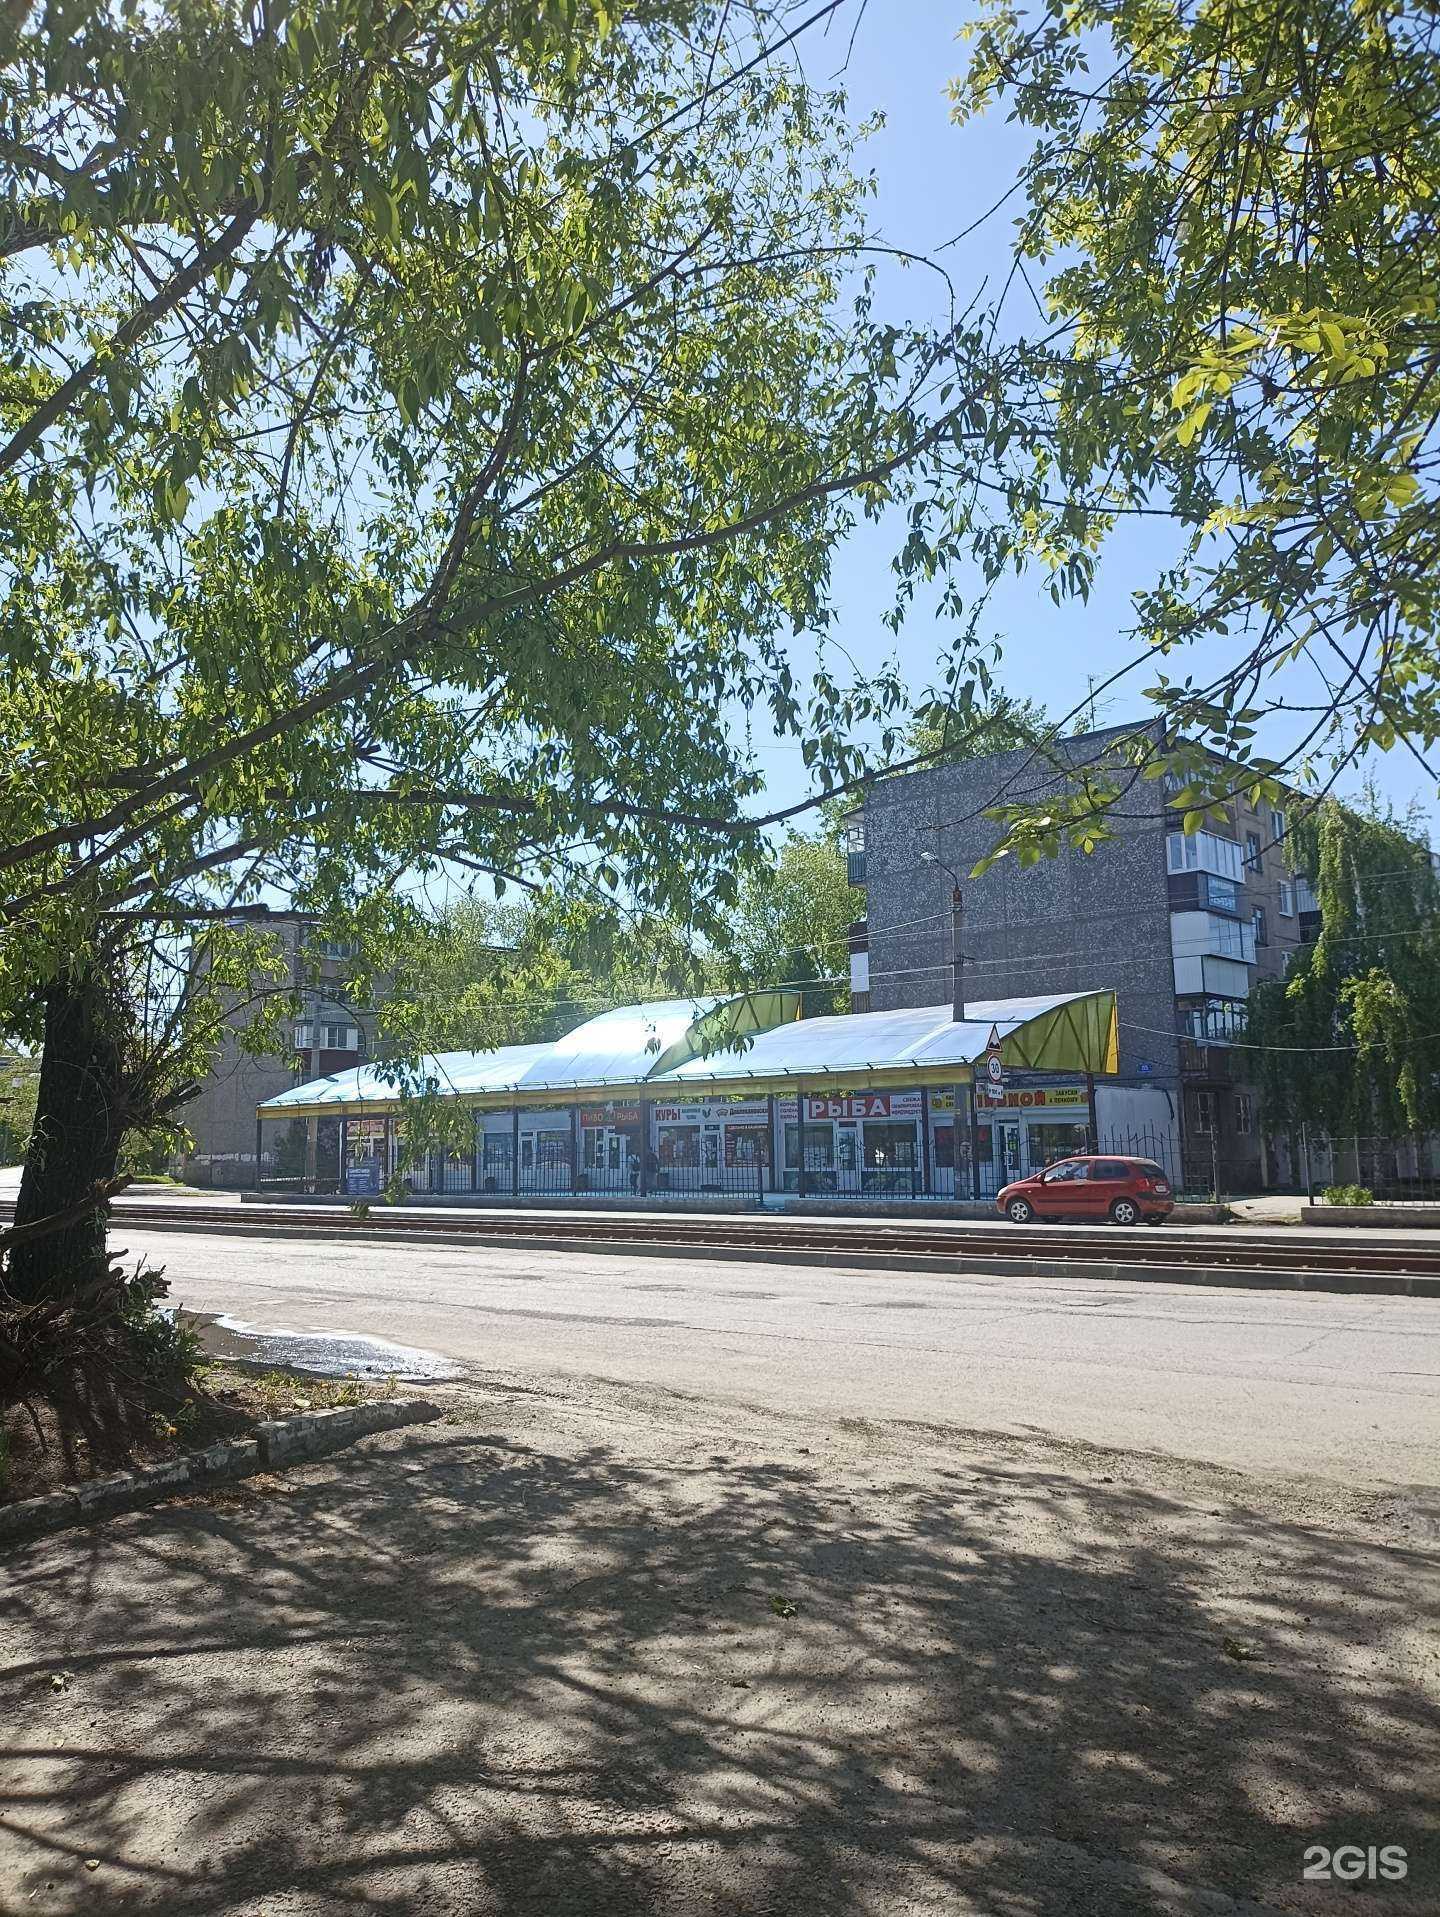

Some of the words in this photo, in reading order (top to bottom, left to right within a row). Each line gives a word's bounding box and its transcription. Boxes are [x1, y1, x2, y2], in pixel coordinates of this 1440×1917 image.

[991, 1063, 1000, 1073] 30
[811, 1098, 887, 1117] РЫБА
[617, 1111, 639, 1121] РЫБА
[655, 1107, 680, 1121] КУРЫ
